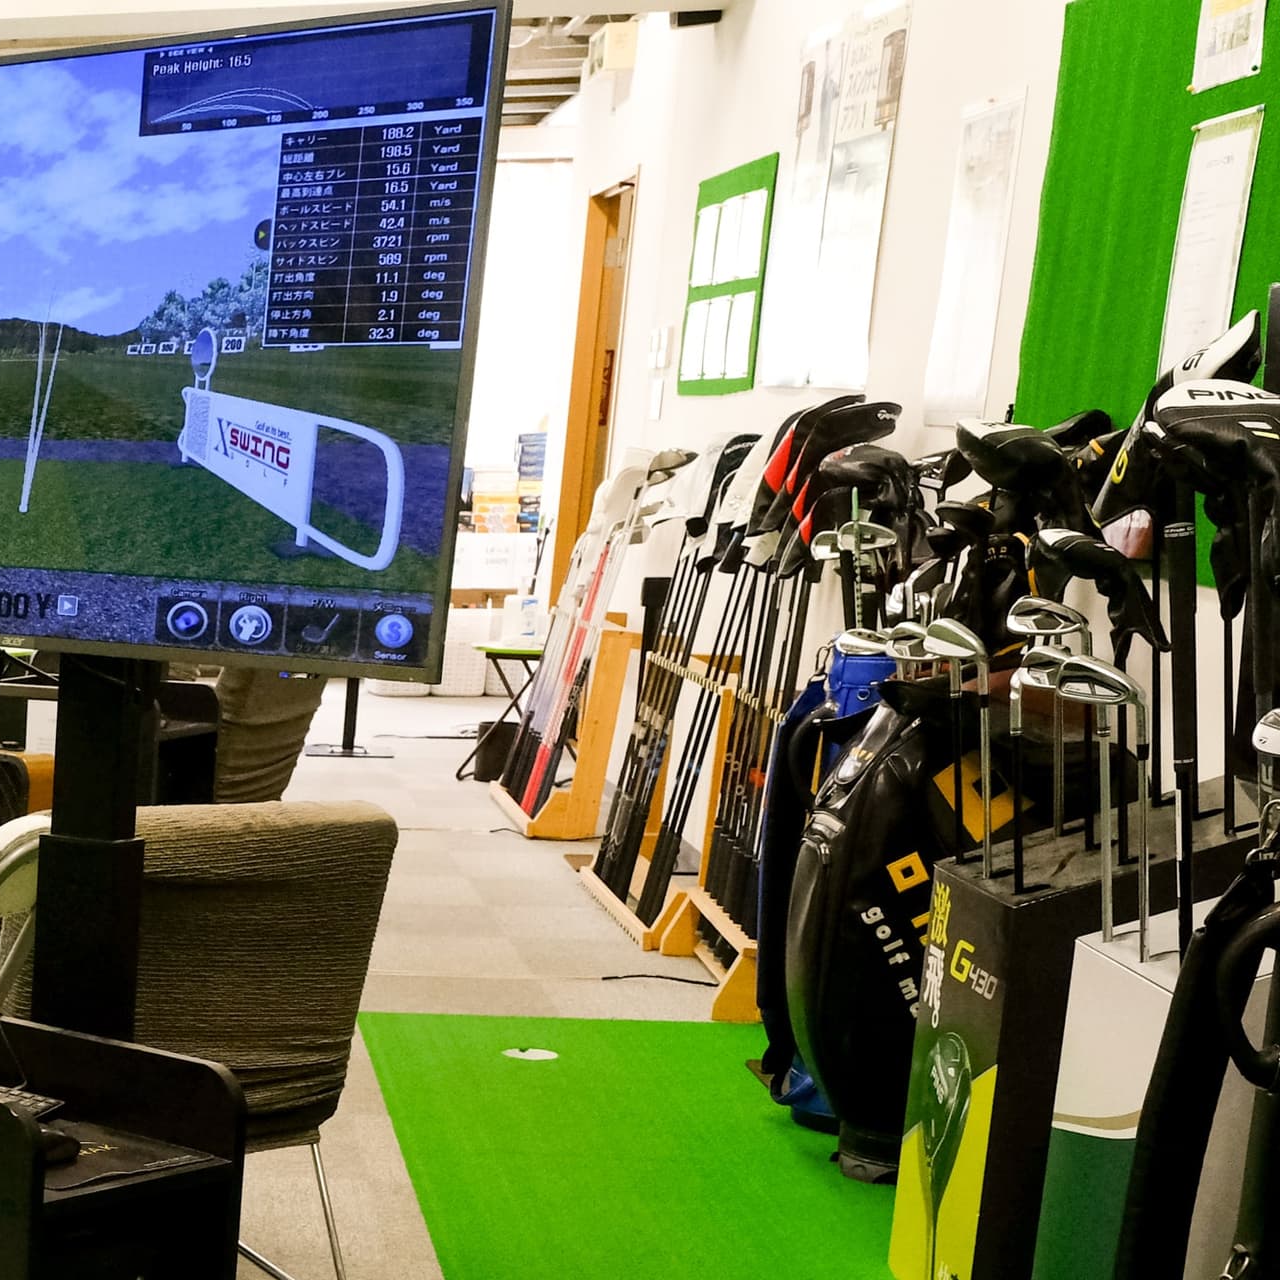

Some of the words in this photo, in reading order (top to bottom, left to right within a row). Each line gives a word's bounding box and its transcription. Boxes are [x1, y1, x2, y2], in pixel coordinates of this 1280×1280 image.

[153, 63, 180, 76] Peak
[184, 58, 224, 74] Height:
[230, 54, 252, 68] 16.5
[222, 118, 237, 127] 100
[266, 114, 282, 123] 150
[312, 110, 328, 119] 200
[358, 106, 375, 115] 250
[406, 101, 424, 111] 300
[455, 97, 473, 107] 350
[434, 124, 462, 135] Yard
[381, 144, 412, 158] 198.5
[433, 144, 460, 154] Yard
[430, 162, 458, 172] Yard
[384, 181, 409, 194] 16.5
[429, 181, 457, 191] Yard
[381, 199, 406, 212] 54.1
[429, 198, 451, 208] m/s
[379, 217, 405, 230] 42.4
[428, 216, 451, 226] m/s
[373, 235, 402, 248] 3721
[426, 233, 450, 243] rpm
[424, 253, 448, 263] rpm
[376, 271, 399, 284] 11.1
[423, 271, 445, 281] deg
[381, 290, 398, 302] 1.9
[421, 289, 443, 300] deg
[377, 309, 395, 321] 2.1
[418, 309, 440, 321] deg
[368, 327, 395, 340] 32.3
[417, 328, 439, 339] deg
[224, 338, 243, 351] 200
[229, 427, 290, 470] SWING
[171, 588, 207, 599] Camera
[2, 636, 25, 646] acer
[373, 651, 407, 661] Sensor
[860, 906, 911, 965] golf
[950, 939, 998, 1001] G430
